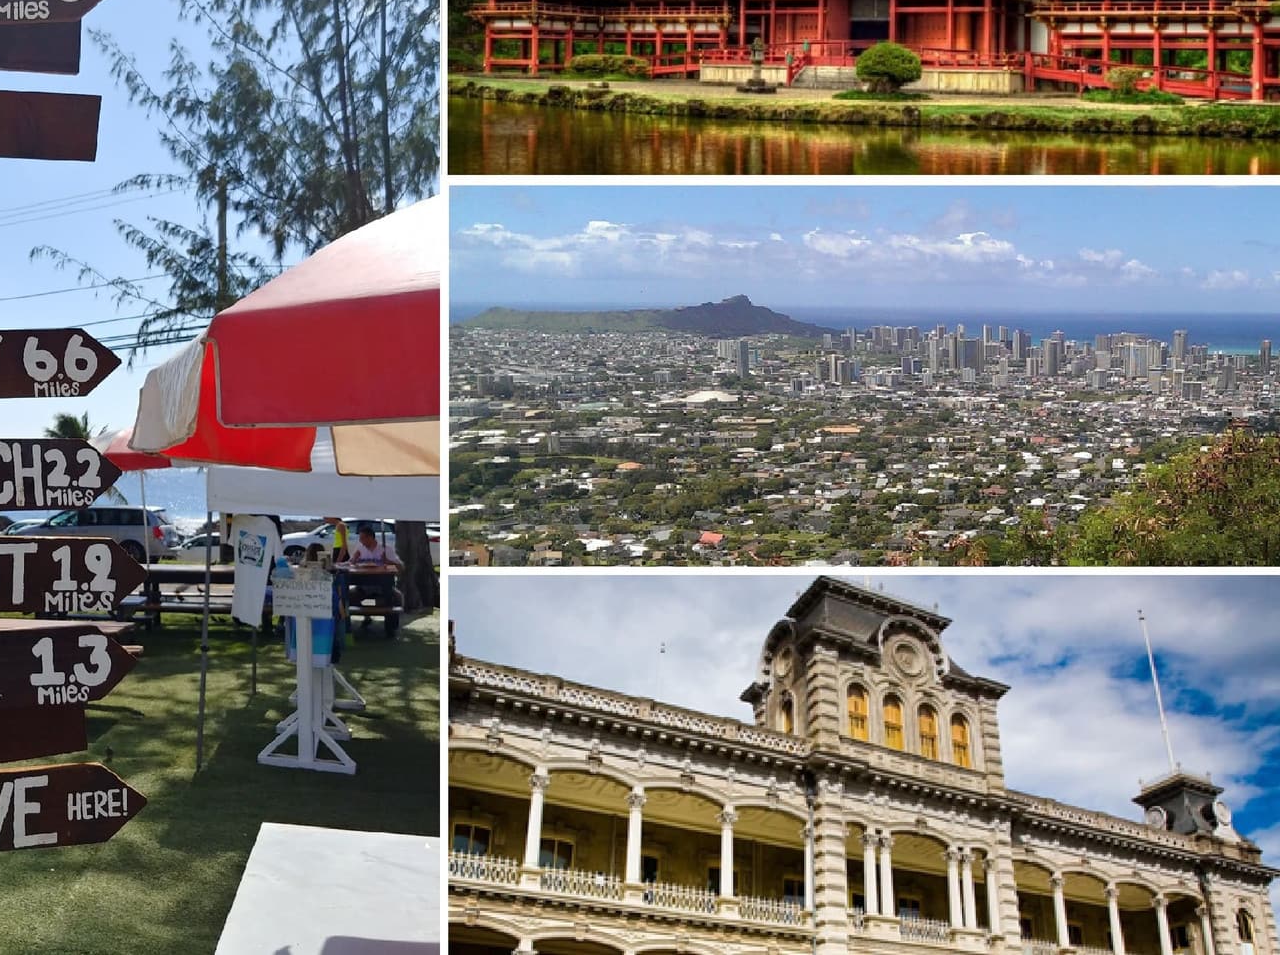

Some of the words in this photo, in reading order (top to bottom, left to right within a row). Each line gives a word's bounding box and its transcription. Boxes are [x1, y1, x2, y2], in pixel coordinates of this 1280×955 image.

[23, 334, 98, 383] 6.6
[34, 381, 80, 398] Miles
[44, 447, 101, 489] 2.2
[46, 487, 94, 508] Miles
[31, 634, 112, 686] 1.3
[38, 685, 88, 705] Miles
[68, 788, 128, 820] HERE!
